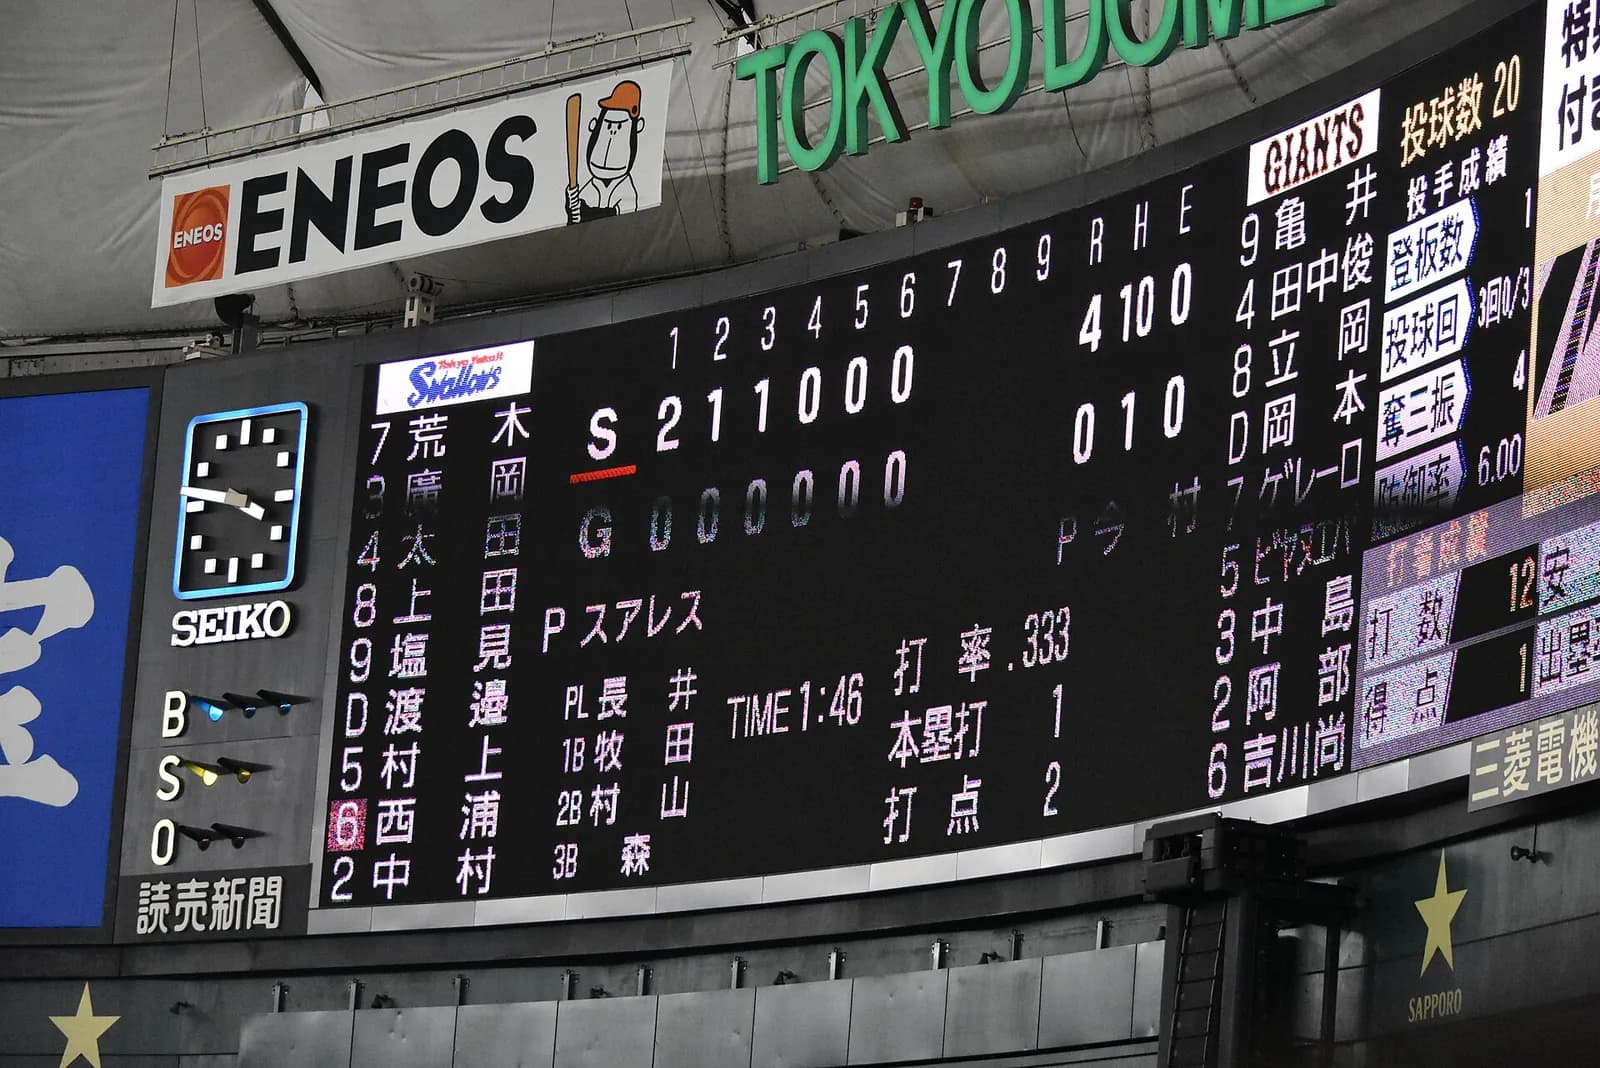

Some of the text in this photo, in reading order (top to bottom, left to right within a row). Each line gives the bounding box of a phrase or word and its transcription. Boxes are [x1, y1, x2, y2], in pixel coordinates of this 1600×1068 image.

[736, 0, 1036, 186] TOKYO
[1400, 54, 1521, 168] 投球数 20
[1264, 102, 1364, 194] GIANTS
[234, 114, 537, 276] ENEOS
[1406, 134, 1509, 222] 投手成績
[173, 222, 223, 249] ENEOS
[1240, 212, 1260, 267] 9
[1390, 212, 1464, 292] 登板数
[1525, 187, 1533, 228] 1
[670, 184, 1194, 369] 1 2 3 4 5 6 7 8 9 R H E
[1236, 232, 1374, 330] 4 田中俊
[1385, 294, 1459, 373] 投球回
[407, 361, 502, 408] Swallows
[586, 262, 1192, 461] S 2 1 1 0 0 0 4 10 0
[1232, 343, 1252, 398] 8
[1381, 349, 1526, 447] 奪三振 4
[371, 422, 391, 466] 7
[1228, 410, 1249, 465] D
[1477, 433, 1522, 487] 6.00
[578, 374, 1185, 560] G 0 0 0 0 0 0 0 1 0
[357, 530, 381, 572] 4
[1057, 517, 1077, 566] P
[1219, 544, 1240, 598] 5
[171, 600, 292, 648] SEIKO
[354, 583, 377, 628] 8
[542, 590, 703, 654] P スアレス
[1369, 590, 1444, 660] 打数
[1510, 556, 1536, 612] 12
[350, 638, 372, 683] 9
[1007, 606, 1071, 672] .333
[1215, 608, 1236, 665] 3
[162, 690, 187, 738] B
[345, 691, 368, 737] D
[564, 684, 589, 720] PL
[727, 672, 864, 739] TIME 1:46
[1211, 675, 1233, 732] 2
[1364, 668, 1438, 740] 得点
[1519, 643, 1527, 692] 1
[887, 683, 1064, 769] 本塁打 1
[156, 755, 183, 801] S
[340, 746, 363, 792] 5
[562, 737, 585, 774] 1B
[1208, 711, 1346, 799] 6 吉川尚
[1471, 710, 1598, 802] 三菱電機
[556, 788, 582, 827] 2B
[1043, 760, 1062, 817] 2
[151, 819, 175, 866] O
[336, 801, 359, 847] 6
[331, 856, 355, 902] 2
[553, 832, 651, 880] 3B 森
[136, 876, 283, 935] 読売新聞
[1408, 987, 1463, 1023] SAPPORO
